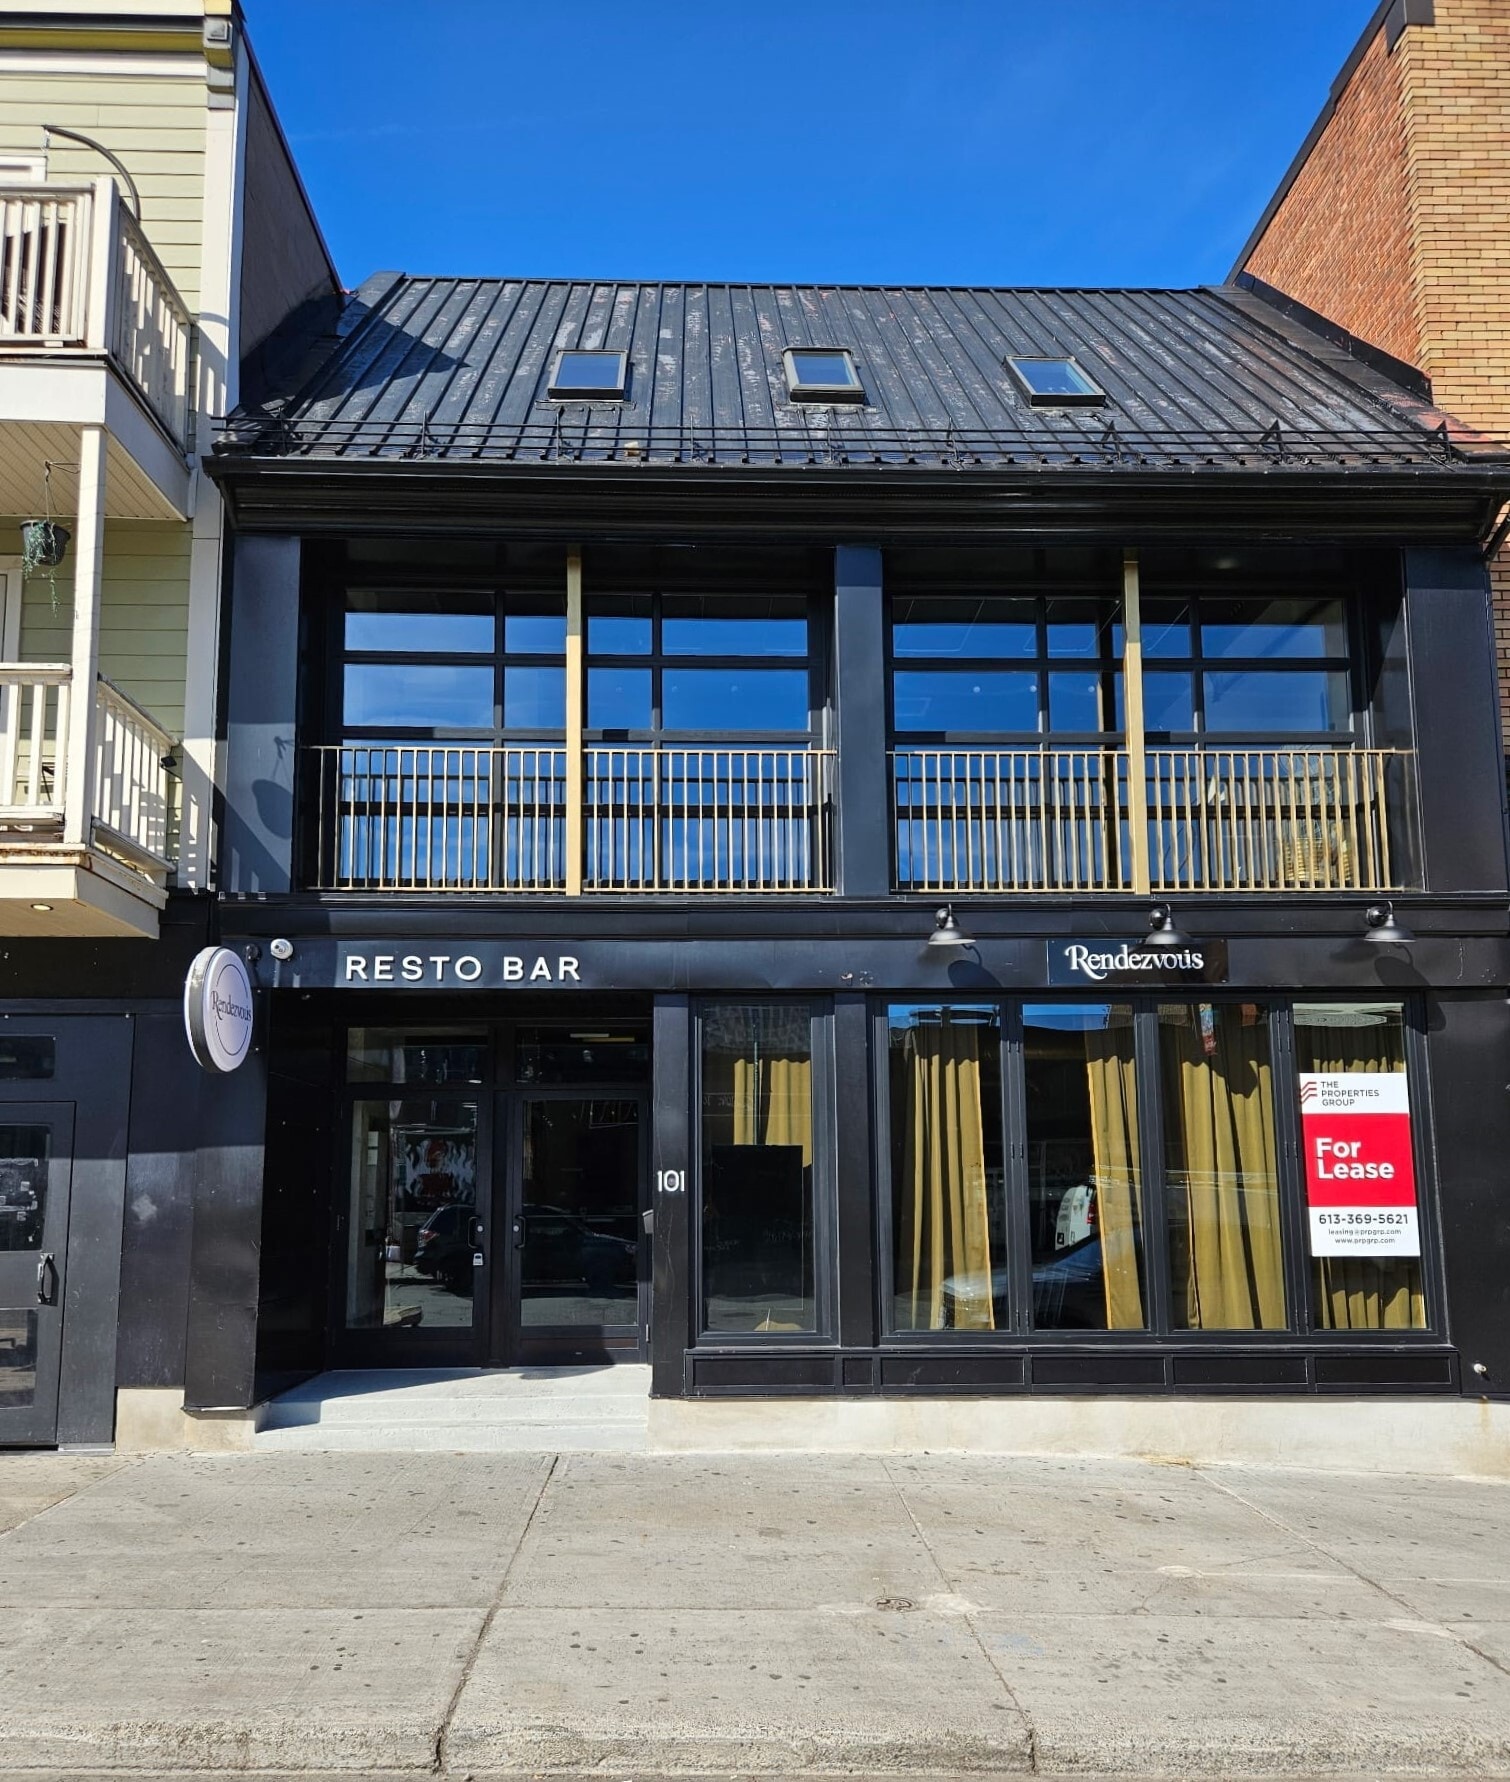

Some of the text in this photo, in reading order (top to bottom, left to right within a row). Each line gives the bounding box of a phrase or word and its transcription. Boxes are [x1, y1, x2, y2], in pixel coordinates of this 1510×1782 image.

[345, 955, 581, 981] RESTO BAR
[1064, 944, 1204, 980] Rendezvous
[211, 990, 252, 1022] Rendezvous
[1321, 1081, 1339, 1089] THE
[1321, 1089, 1380, 1097] PROPERTIES
[1322, 1098, 1355, 1107] GROUP
[1315, 1137, 1361, 1158] For
[1317, 1157, 1395, 1180] Lease
[657, 1169, 685, 1192] 101
[1319, 1213, 1408, 1225] 613-369-5621
[1334, 1237, 1396, 1245] www.prpgrp.com
